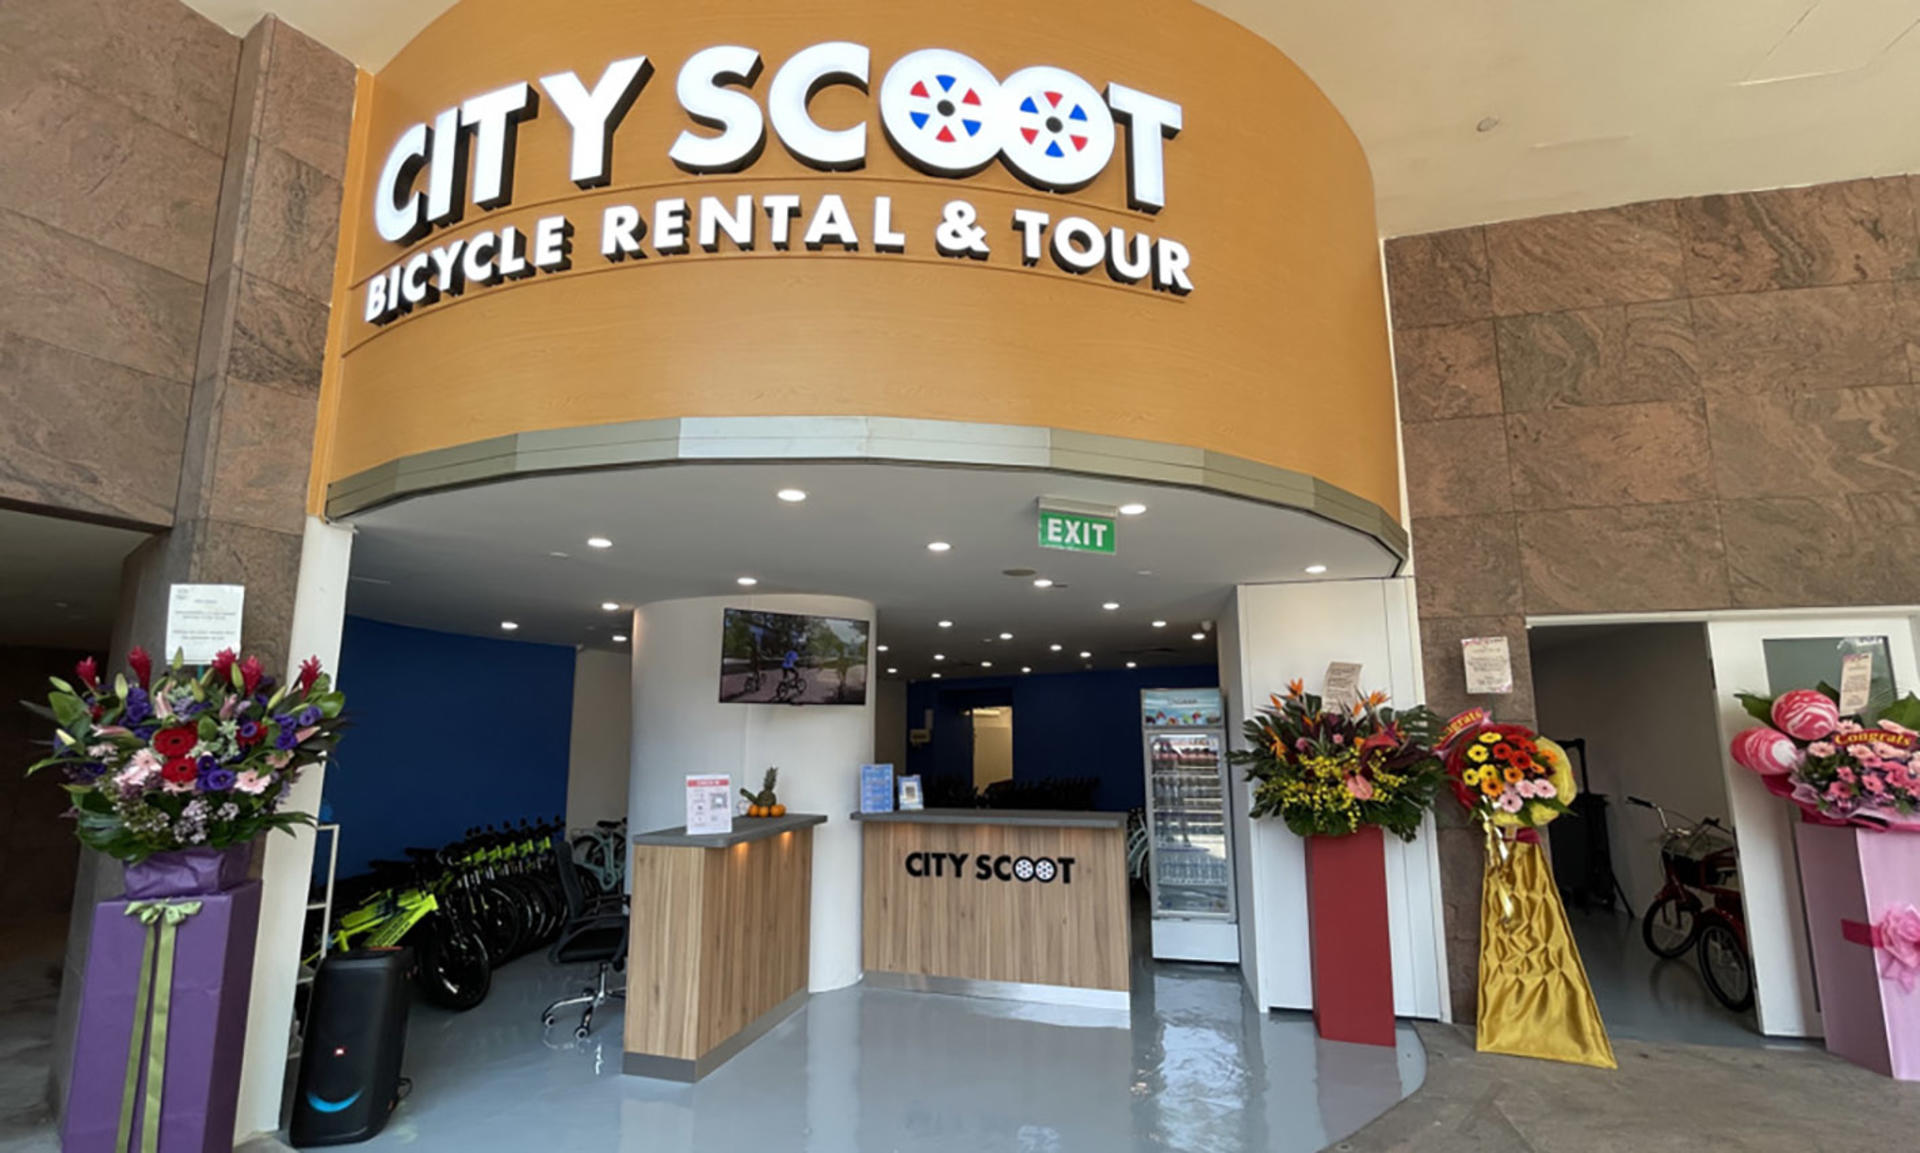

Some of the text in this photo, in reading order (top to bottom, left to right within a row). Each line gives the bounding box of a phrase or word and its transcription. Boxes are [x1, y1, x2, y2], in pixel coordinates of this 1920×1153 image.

[374, 41, 1182, 246] CITY SCOOT
[365, 194, 1194, 326] BICYCLE RENTAL & TOUR
[1047, 518, 1107, 547] EXIT
[905, 852, 1075, 884] CITY SCOOT
